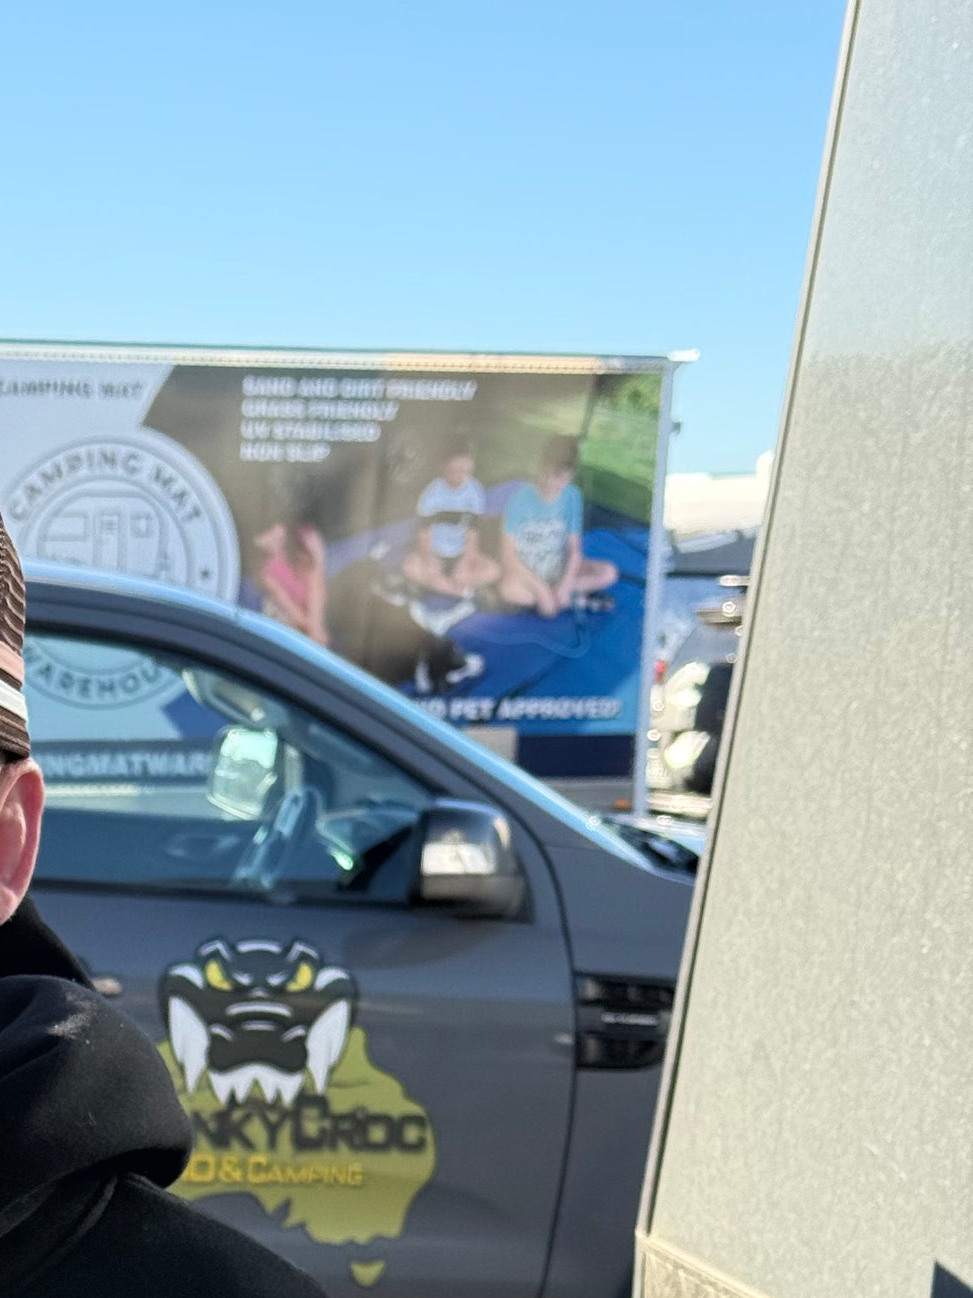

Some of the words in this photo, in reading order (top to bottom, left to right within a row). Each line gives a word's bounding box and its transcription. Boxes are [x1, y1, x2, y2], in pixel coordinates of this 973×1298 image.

[98, 380, 144, 400] MAT
[8, 447, 142, 522] CAMPING
[153, 462, 203, 524] MAT
[24, 644, 160, 696] WAREHOU
[450, 697, 495, 720] PET
